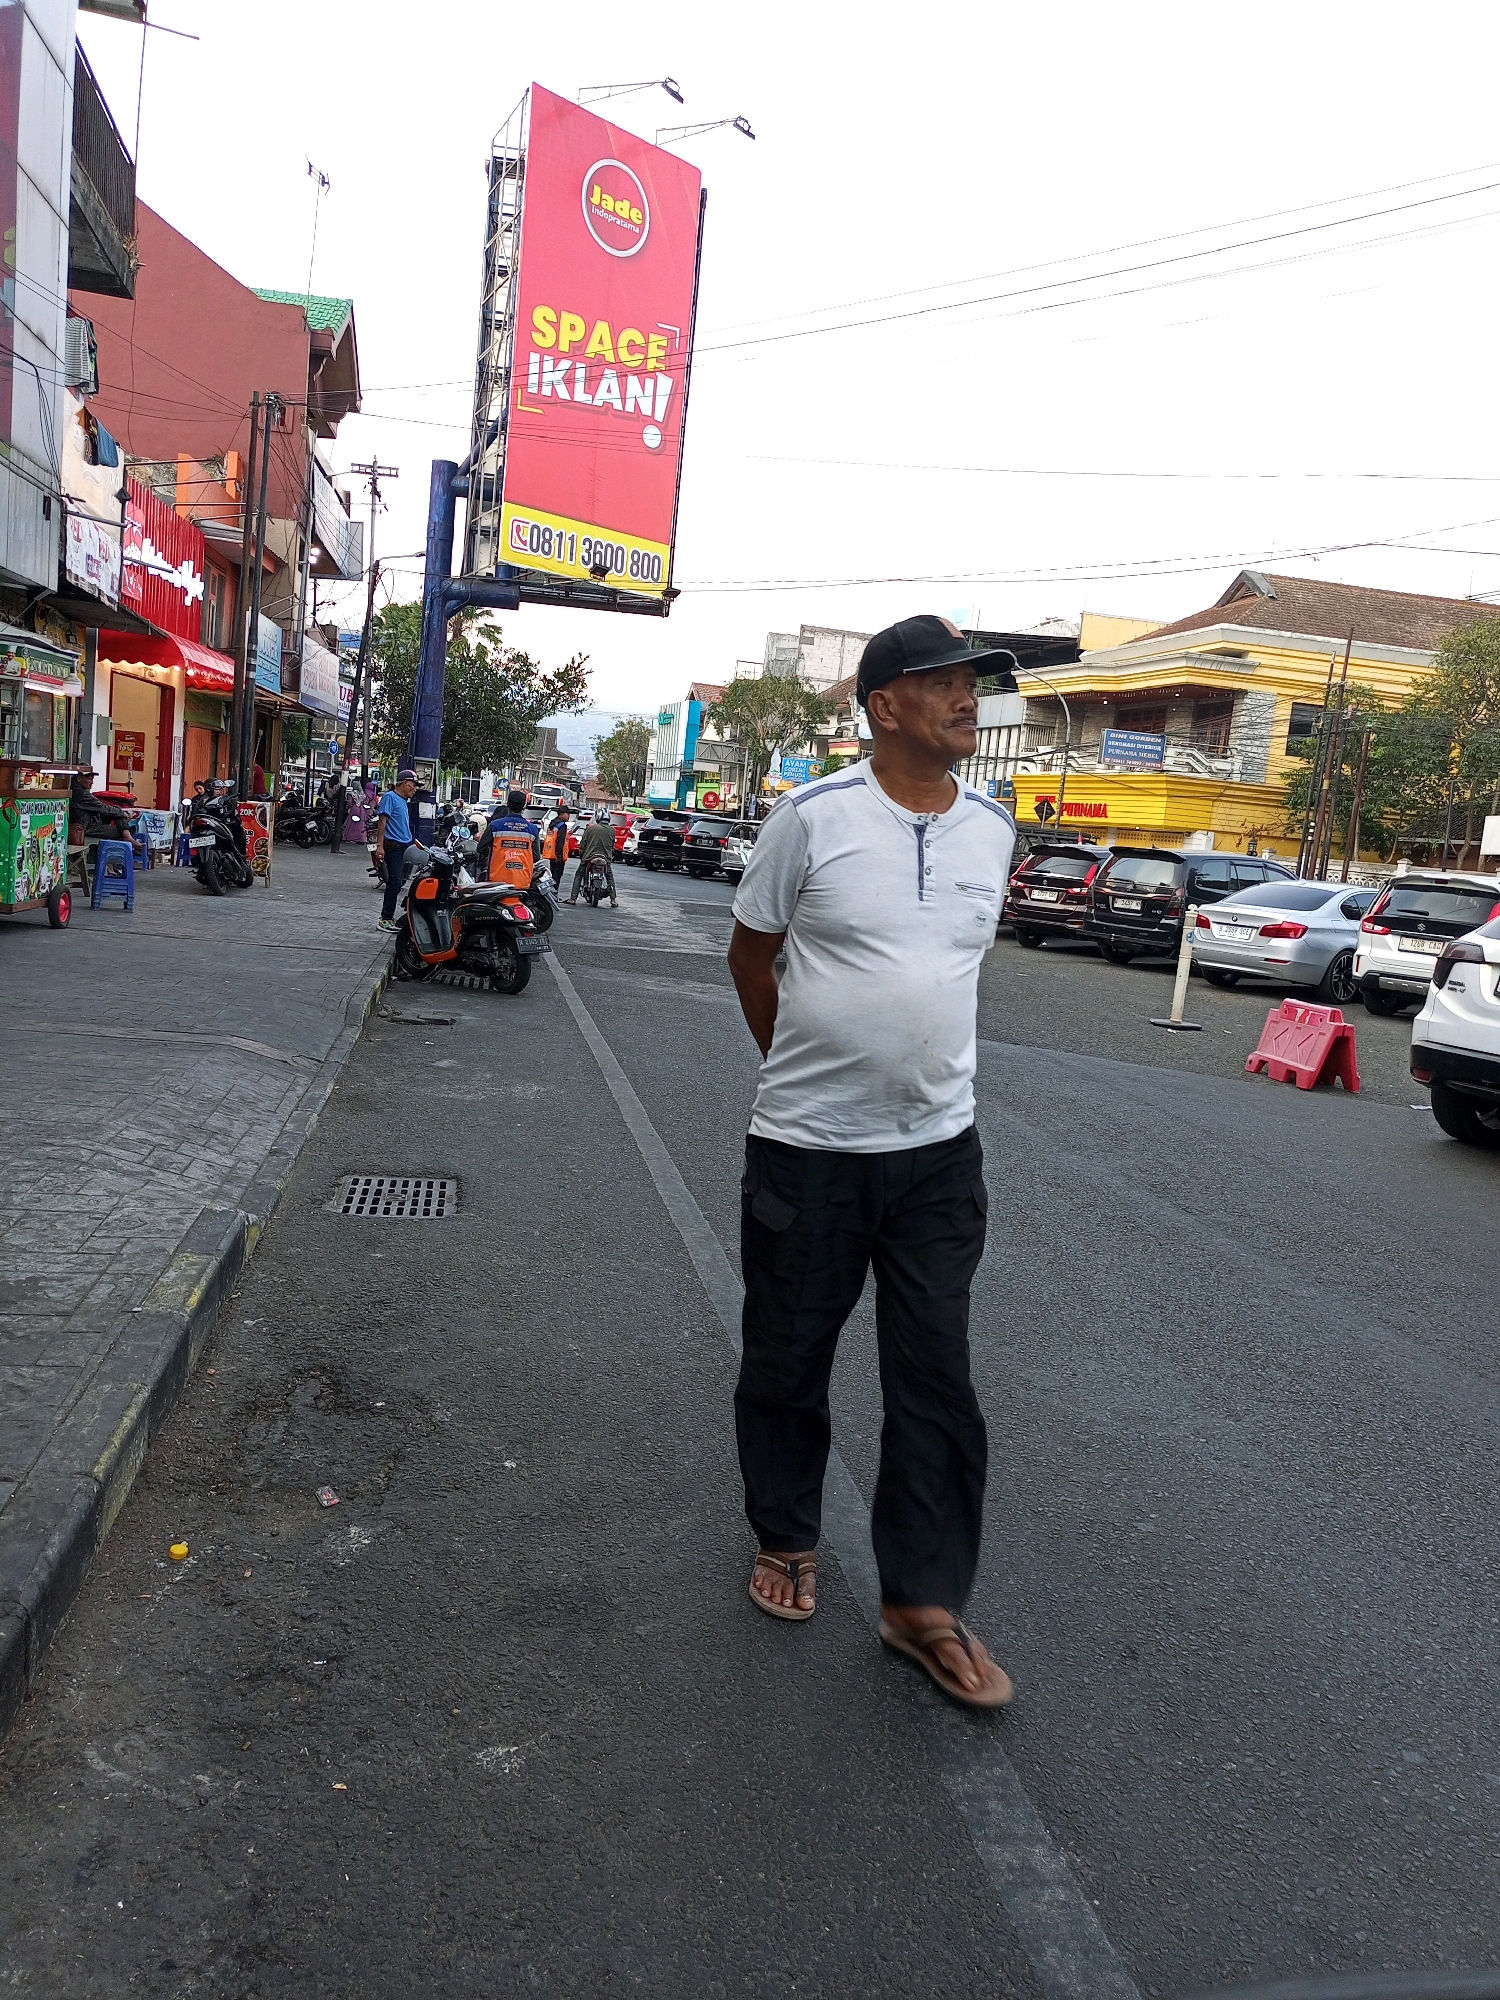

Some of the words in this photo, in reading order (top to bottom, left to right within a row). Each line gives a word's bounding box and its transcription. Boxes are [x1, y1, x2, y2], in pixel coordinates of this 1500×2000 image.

[589, 184, 643, 225] Jade
[591, 205, 640, 234] Indopratama
[530, 304, 668, 372] SPACE
[527, 351, 674, 449] IKLAN!
[529, 523, 576, 563] 0811
[581, 537, 626, 575] 3600
[629, 549, 662, 583] 800
[1129, 734, 1162, 743] GORDEN
[1107, 748, 1137, 757] PURNAMA
[1138, 752, 1160, 760] MEBEL
[784, 760, 807, 768] AYAM
[783, 771, 806, 779] PEMUDA
[239, 808, 255, 817] 20K
[1060, 802, 1109, 818] PURNAMA
